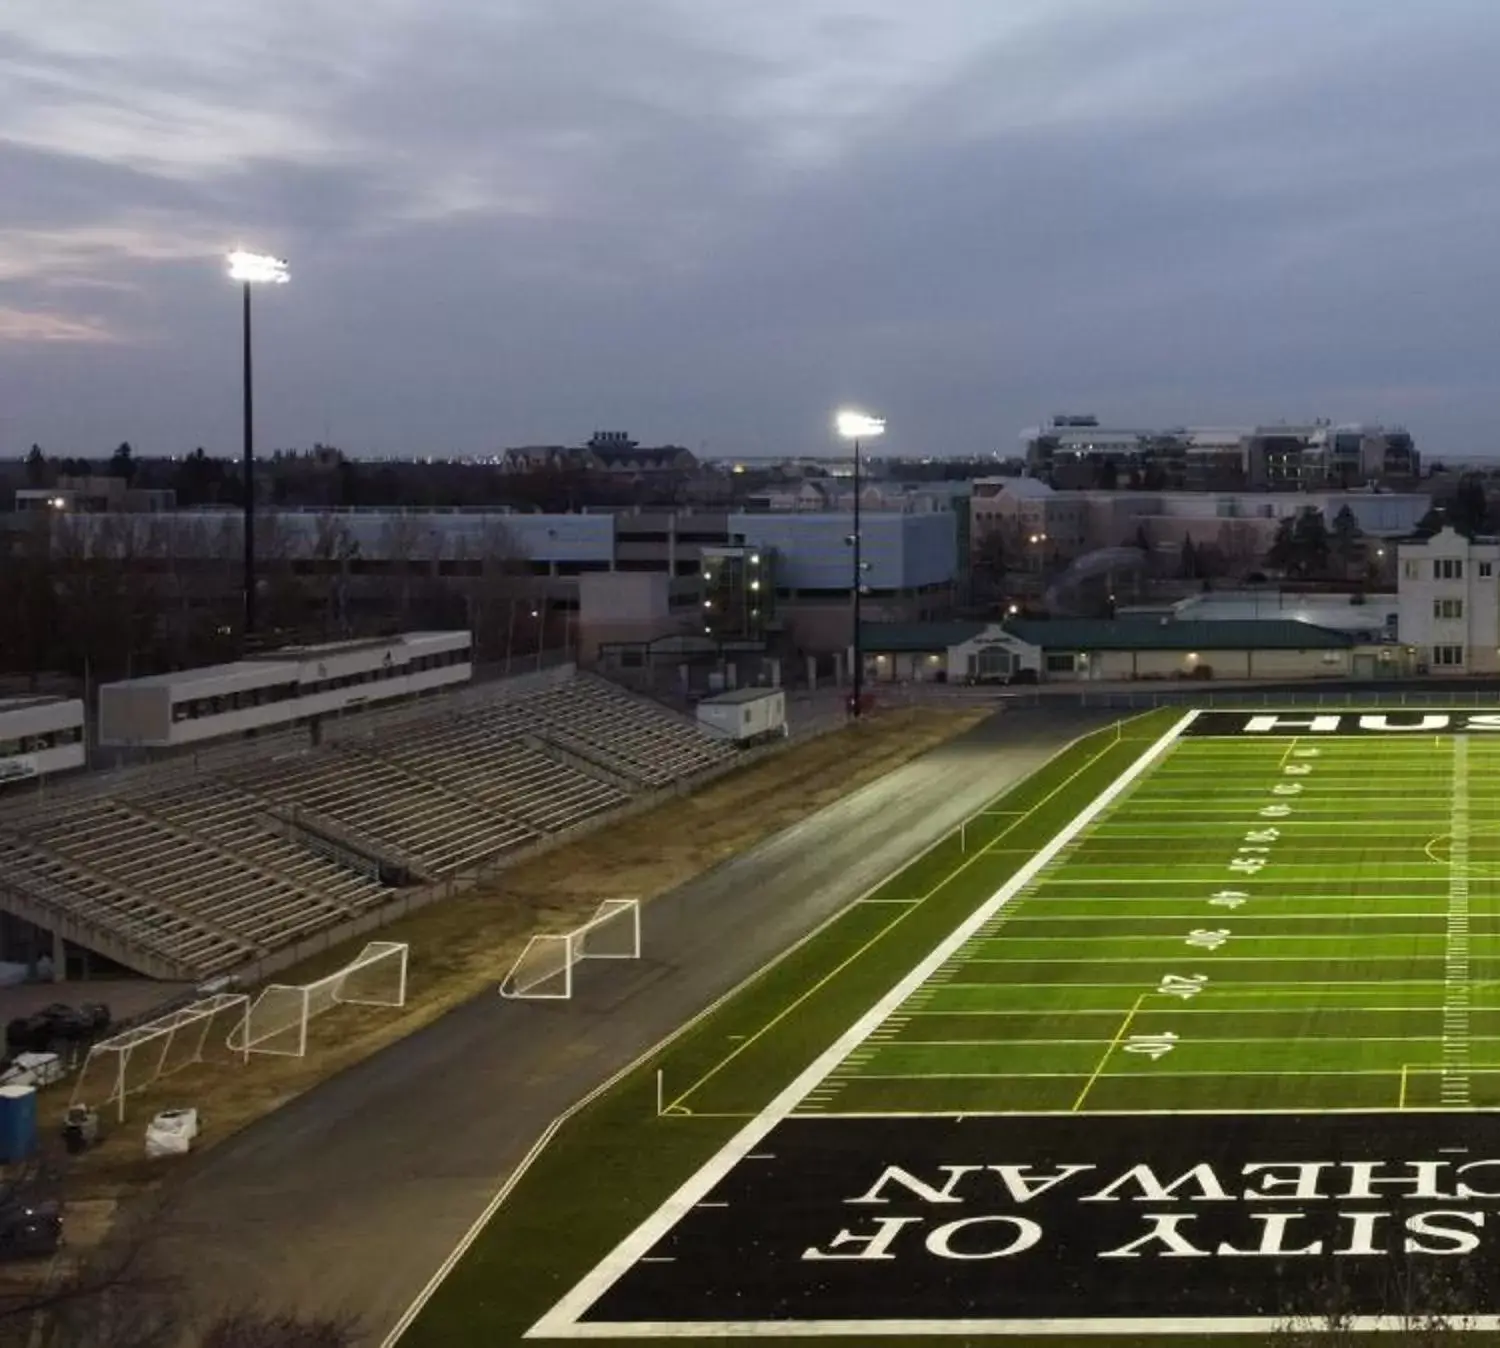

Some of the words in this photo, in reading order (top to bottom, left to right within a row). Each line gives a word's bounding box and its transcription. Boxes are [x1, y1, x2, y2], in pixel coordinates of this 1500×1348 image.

[1157, 974, 1208, 995] 20
[1123, 1031, 1179, 1053] 10
[801, 1214, 1043, 1259] OF
